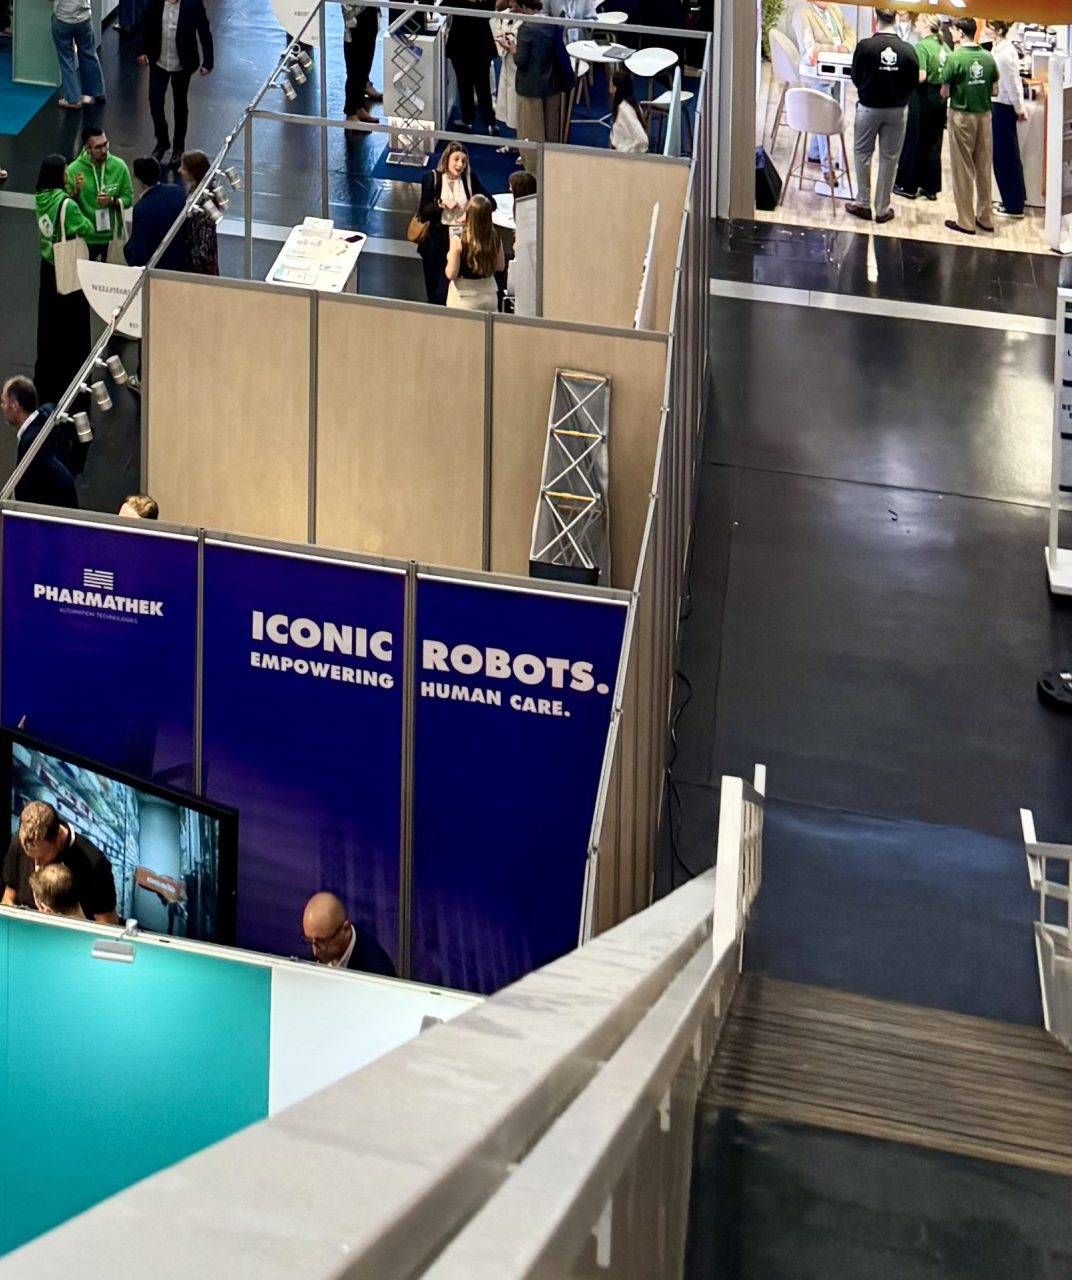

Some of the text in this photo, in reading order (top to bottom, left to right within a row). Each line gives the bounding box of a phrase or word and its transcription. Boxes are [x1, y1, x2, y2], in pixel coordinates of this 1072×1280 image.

[33, 583, 164, 617] PHARMATHEK
[59, 607, 95, 617] AUTOMATION
[252, 610, 393, 662] ICONIC
[250, 651, 395, 690] EMPOWERING
[422, 639, 610, 695] ROBOTS.
[420, 681, 571, 718] HUMAN CARE.
